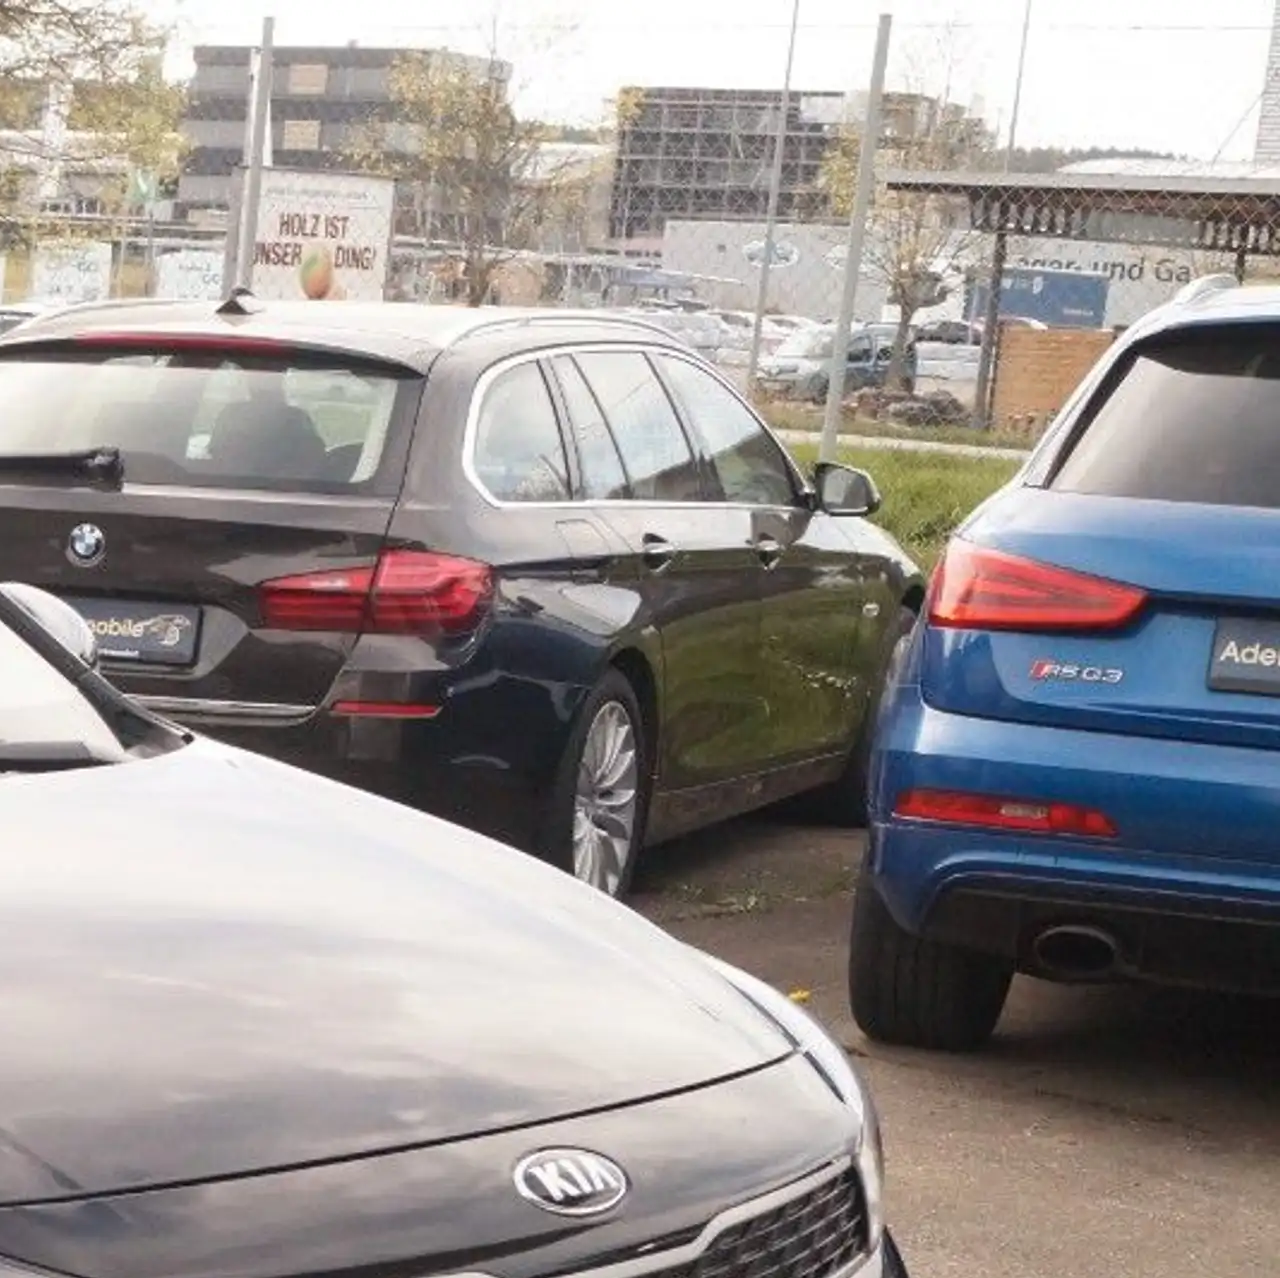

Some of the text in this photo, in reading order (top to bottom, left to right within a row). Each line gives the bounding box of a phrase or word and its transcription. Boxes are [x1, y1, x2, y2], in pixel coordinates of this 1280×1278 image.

[279, 213, 349, 239] HOLZ IST
[528, 1155, 620, 1200] KIA
